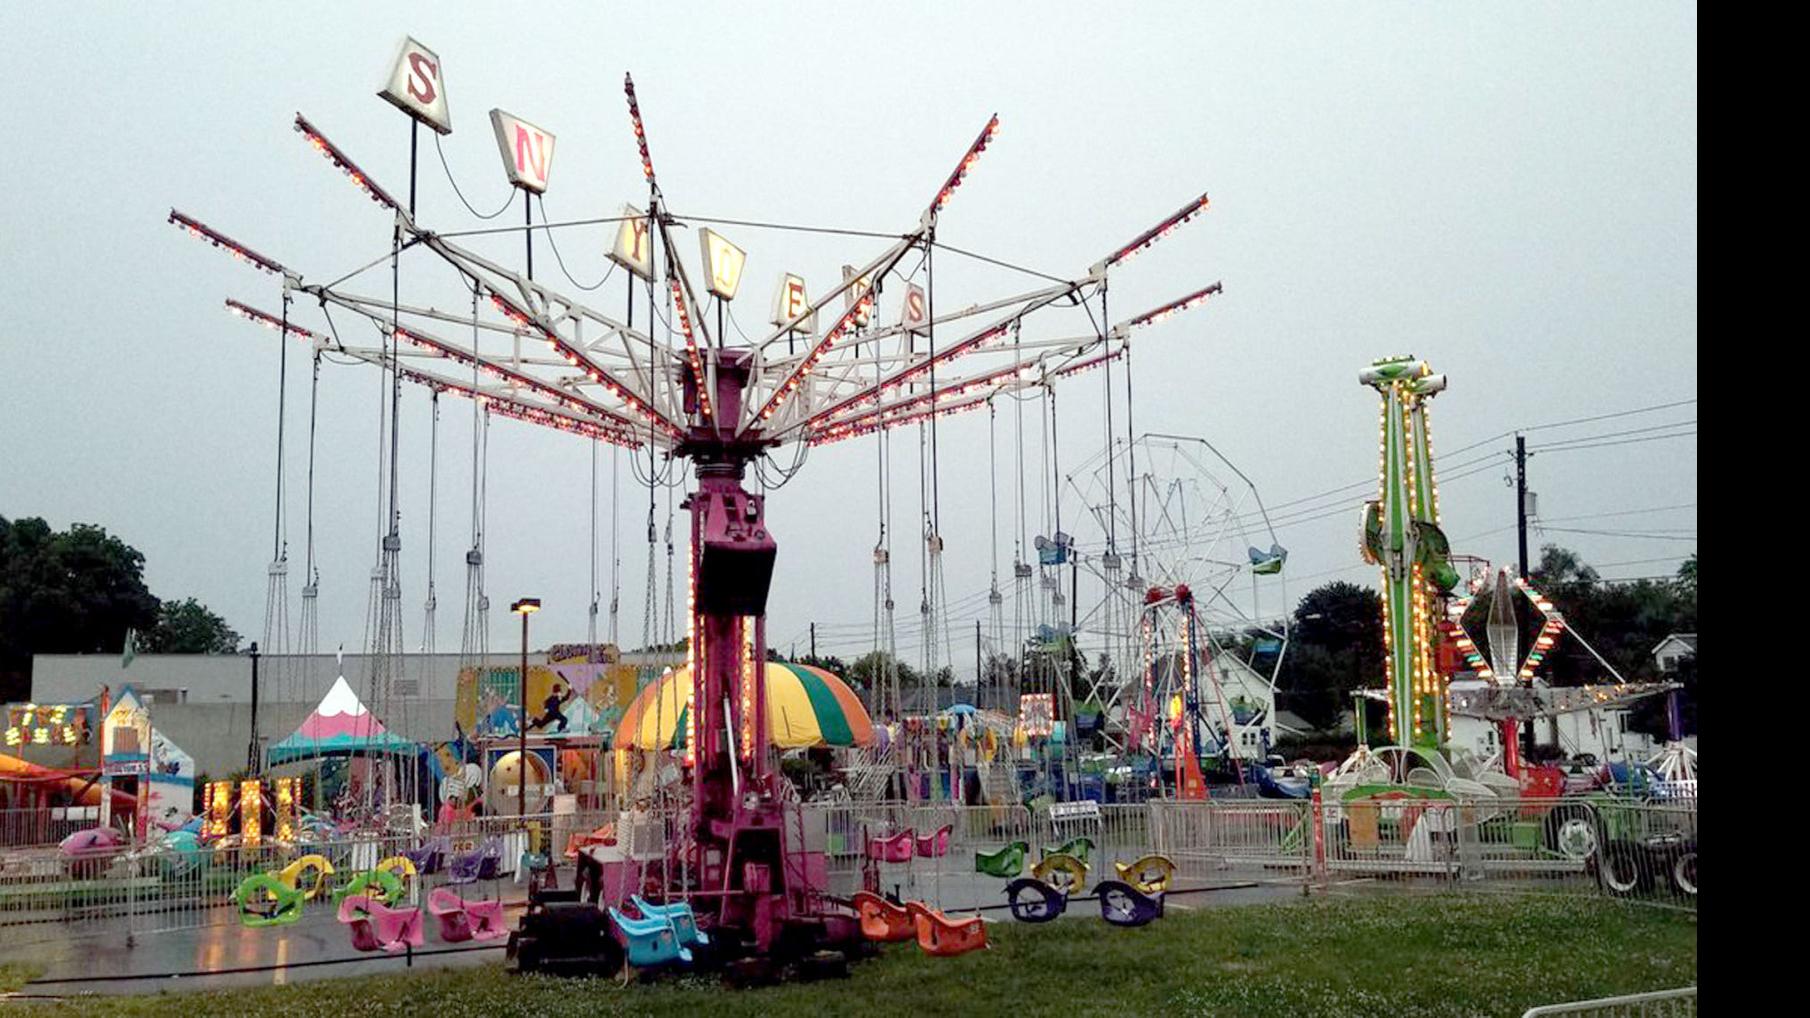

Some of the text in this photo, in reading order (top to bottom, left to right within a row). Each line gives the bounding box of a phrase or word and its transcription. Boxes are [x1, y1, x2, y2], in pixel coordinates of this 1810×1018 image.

[408, 52, 437, 104] S
[515, 124, 545, 182] N
[630, 216, 648, 262] Y
[787, 282, 804, 319] E
[907, 290, 923, 323] S
